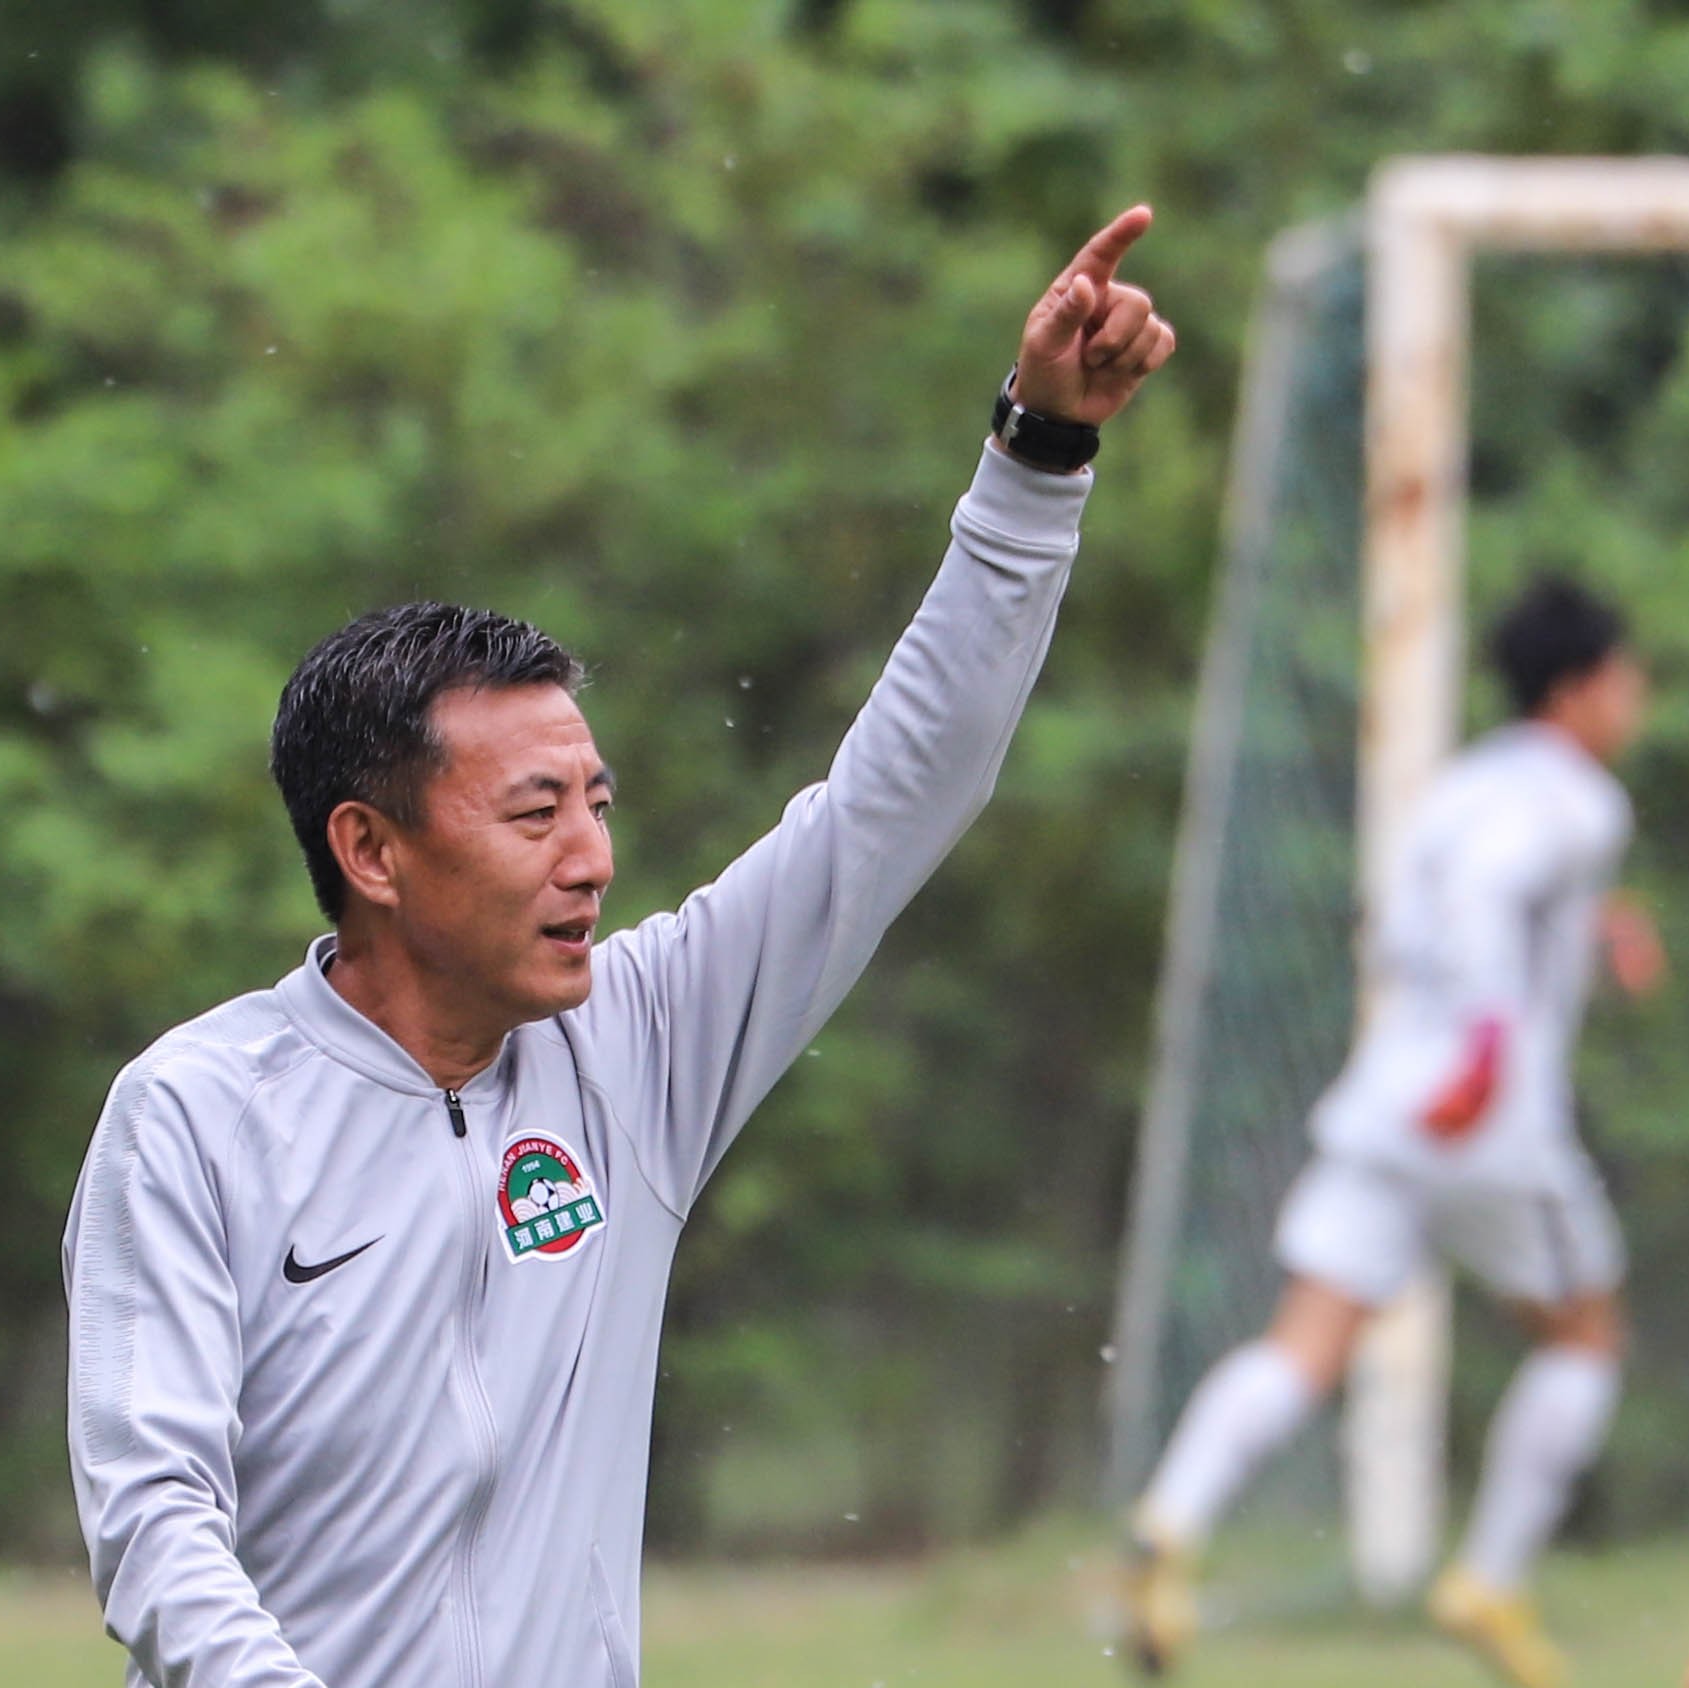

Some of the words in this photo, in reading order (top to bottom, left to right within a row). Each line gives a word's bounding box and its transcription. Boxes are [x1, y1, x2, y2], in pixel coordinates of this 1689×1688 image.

[518, 1141, 553, 1156] JIANYE
[555, 1150, 569, 1165] FC
[521, 1160, 541, 1173] 1994
[514, 1202, 596, 1250] 河南建业
